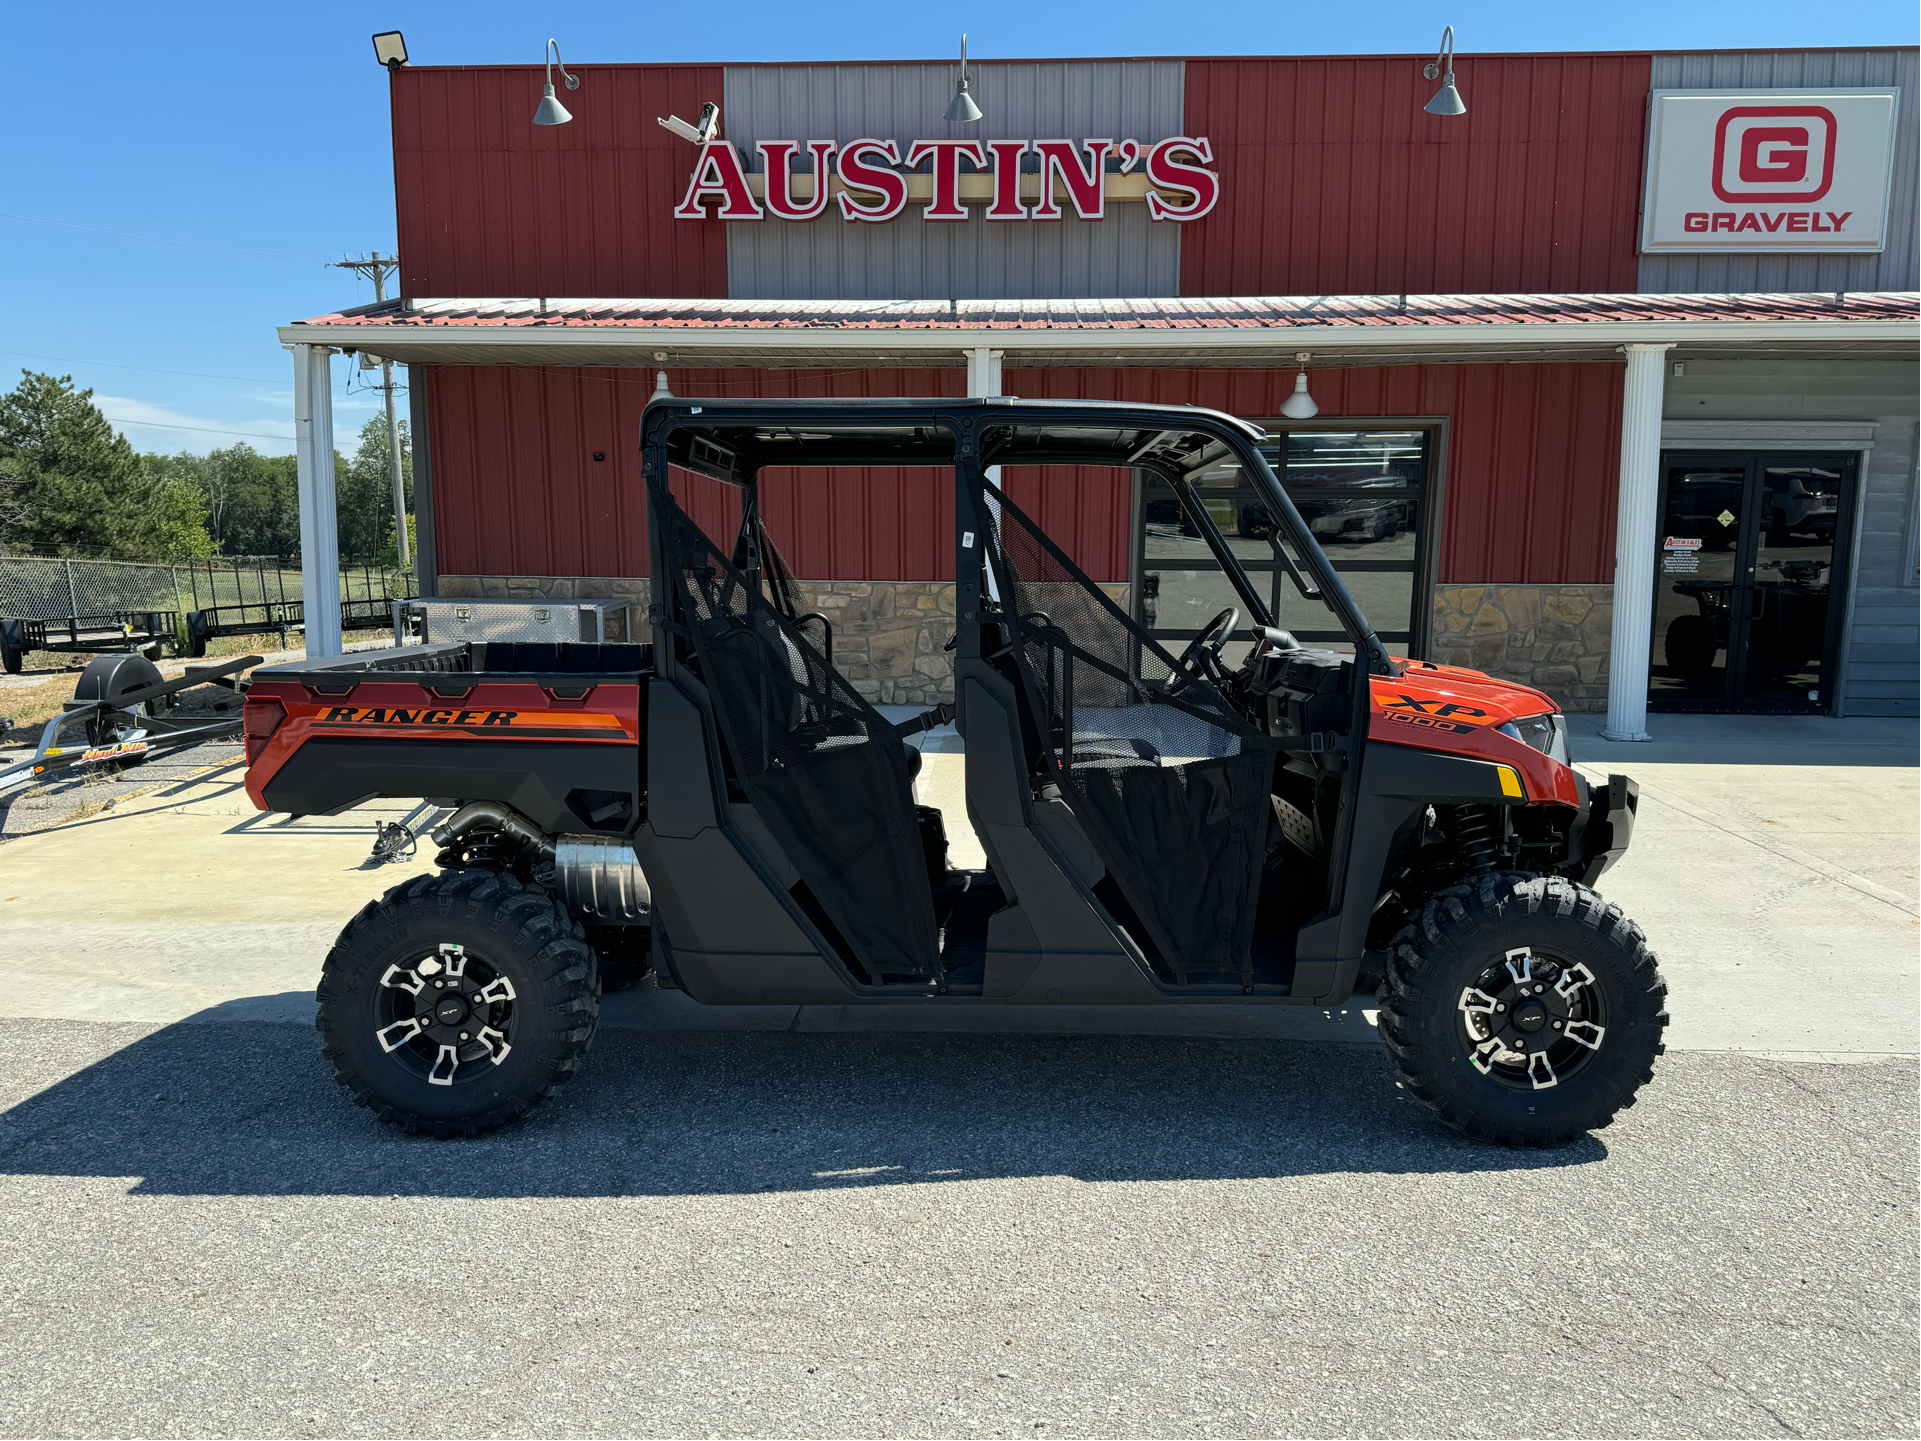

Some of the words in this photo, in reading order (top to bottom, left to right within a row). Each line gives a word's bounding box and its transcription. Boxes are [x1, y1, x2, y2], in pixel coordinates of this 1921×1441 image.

[1739, 127, 1809, 182] G
[674, 137, 1220, 222] AUSTIN'S
[1684, 211, 1853, 233] GRAVELY
[323, 706, 518, 726] RANGER
[1383, 694, 1488, 718] XP
[1384, 711, 1456, 731] 1000
[347, 927, 409, 996] X-TERRAIN
